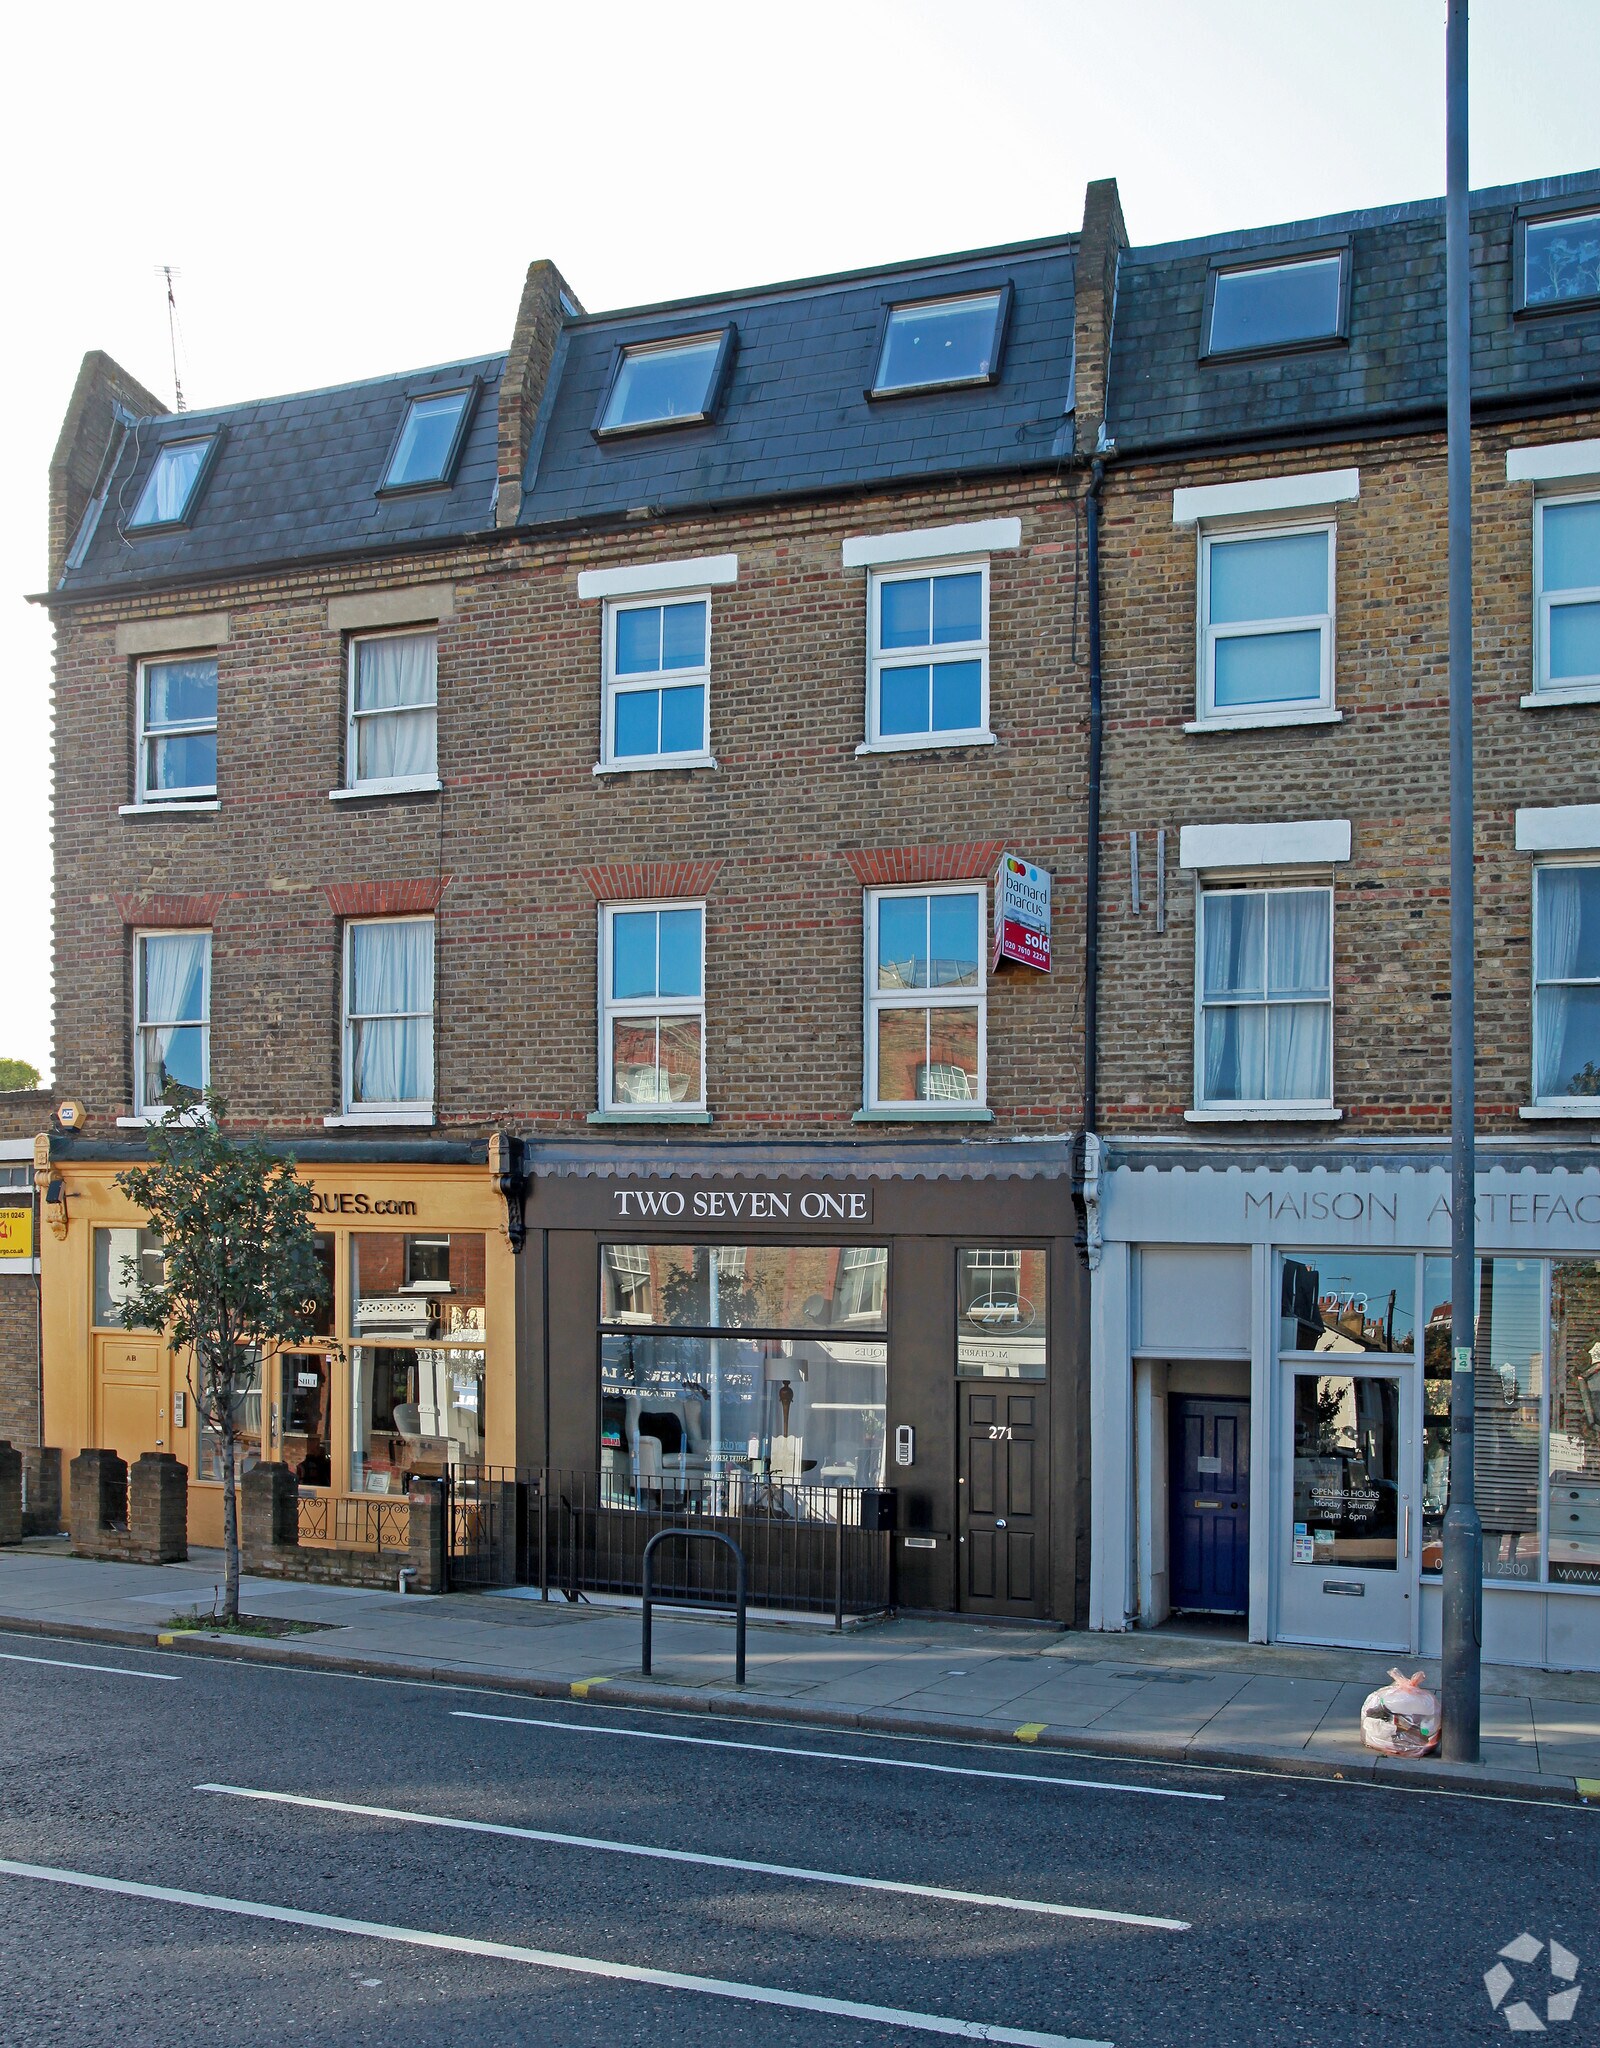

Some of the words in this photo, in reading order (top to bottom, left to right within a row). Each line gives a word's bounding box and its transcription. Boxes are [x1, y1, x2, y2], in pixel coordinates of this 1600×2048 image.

[1006, 872, 1047, 904] barnard
[1006, 891, 1043, 917] marcus
[1005, 940, 1016, 950] 020
[1018, 945, 1031, 956] 7610
[1032, 951, 1046, 962] 2224
[1025, 933, 1050, 953] sold
[614, 1191, 685, 1216] TWO
[693, 1191, 792, 1217] SEVEN
[800, 1193, 867, 1218] ONE
[1244, 1191, 1398, 1223] MAISON
[1427, 1193, 1600, 1224] ATEFAC
[981, 1302, 1021, 1324] 271
[1326, 1291, 1368, 1313] 273
[989, 1425, 1013, 1440] 271
[1311, 1487, 1349, 1497] OPENING
[1350, 1490, 1380, 1499] HOURS
[1313, 1499, 1341, 1509] Monday
[1347, 1502, 1377, 1511] Saturday
[1320, 1510, 1341, 1519] 10am
[1348, 1512, 1367, 1522] 6pm
[1497, 1563, 1529, 1576] 2500
